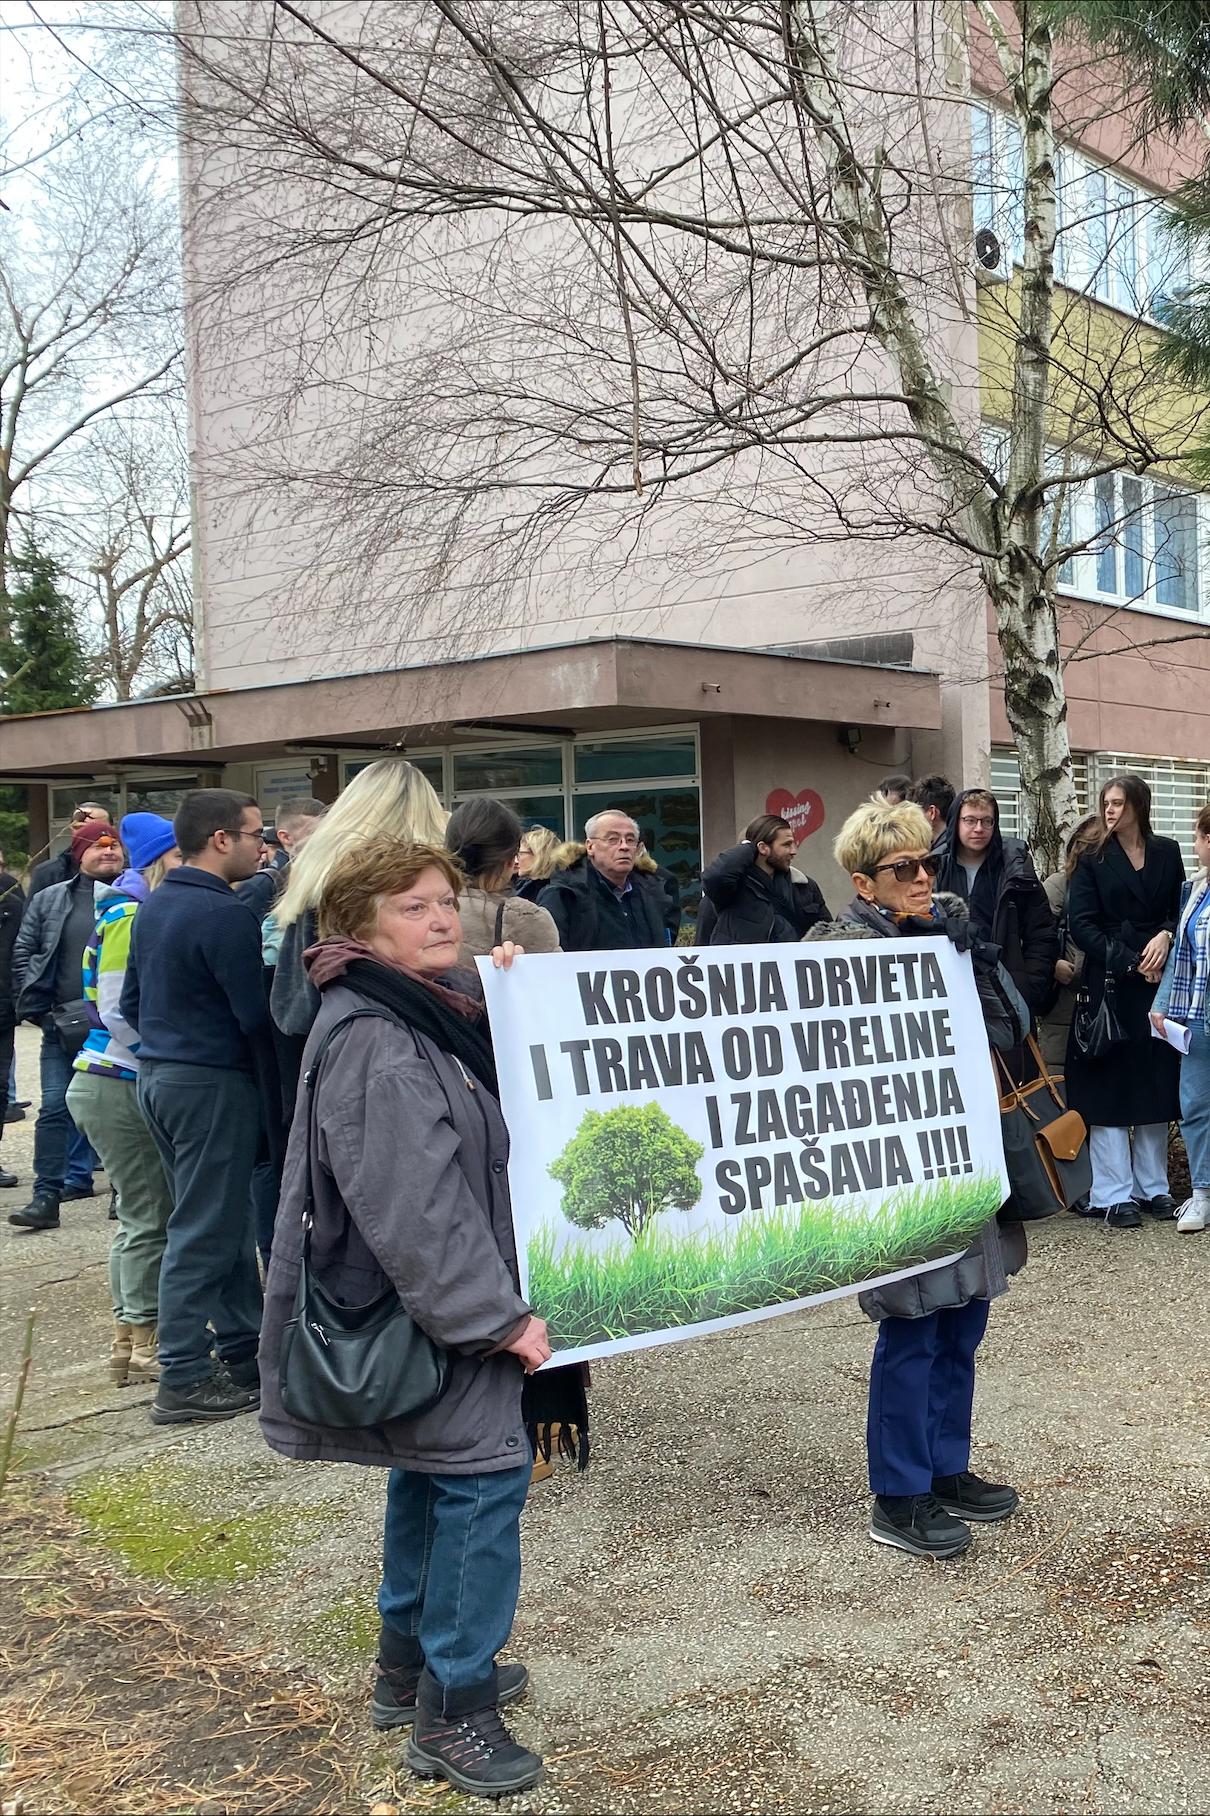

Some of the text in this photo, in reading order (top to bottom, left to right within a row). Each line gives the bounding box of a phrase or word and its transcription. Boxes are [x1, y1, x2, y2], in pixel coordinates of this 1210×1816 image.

[576, 952, 948, 1026] KROŠNJA DRVETA
[529, 1009, 956, 1101] I TRAVA OD VRELINE
[705, 1067, 966, 1149] I ZAGAĐENJA
[715, 1125, 974, 1215] SPAŠAVA !!!!
